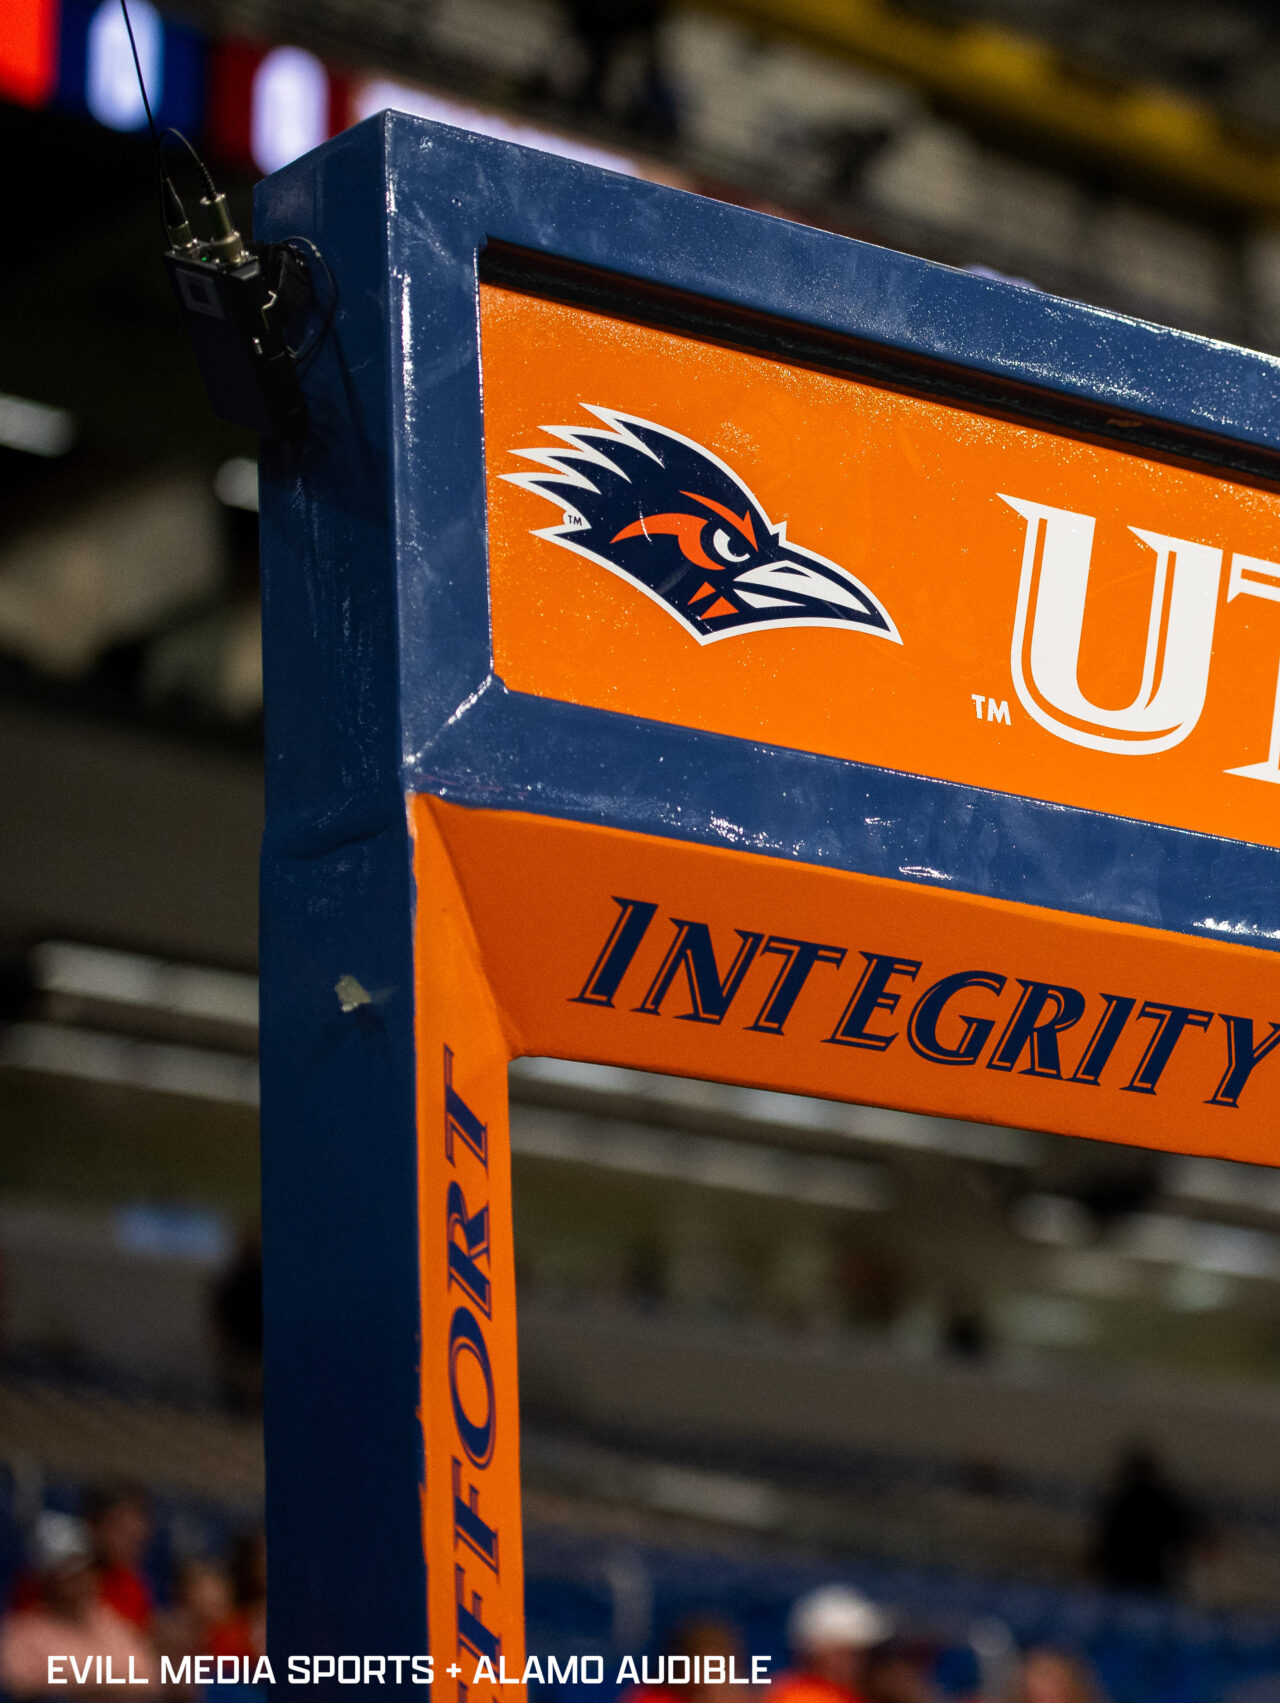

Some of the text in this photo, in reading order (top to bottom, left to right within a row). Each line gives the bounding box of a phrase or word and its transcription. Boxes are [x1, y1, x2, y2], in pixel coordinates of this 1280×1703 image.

[568, 514, 582, 526] TM
[971, 694, 1012, 726] TM
[443, 1043, 504, 1703] FFORT
